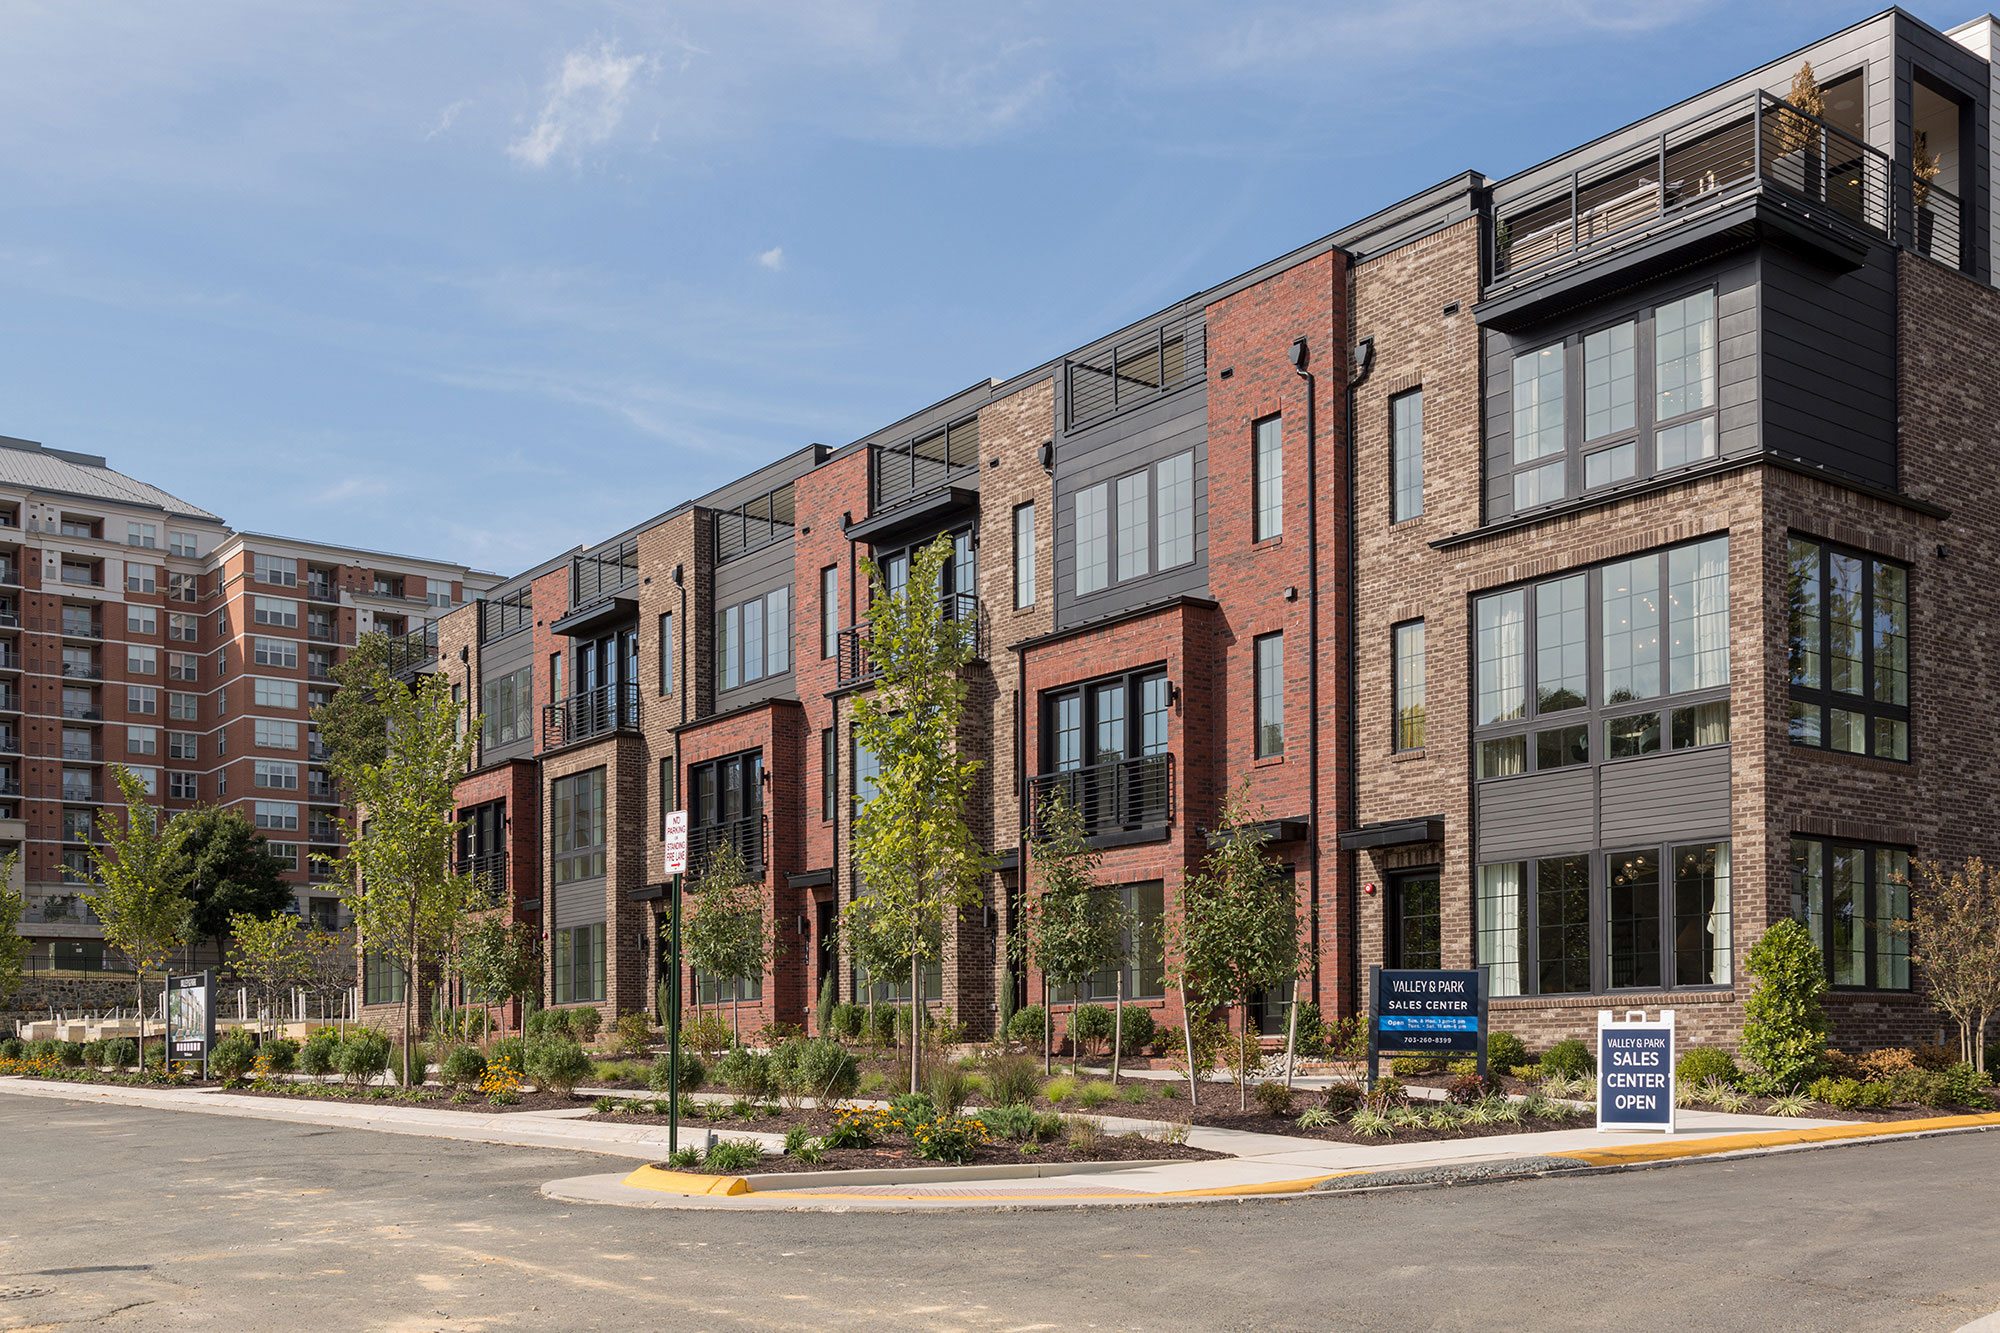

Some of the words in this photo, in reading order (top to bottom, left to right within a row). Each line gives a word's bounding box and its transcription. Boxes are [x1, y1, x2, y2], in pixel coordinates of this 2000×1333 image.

[672, 816, 681, 825] NO
[667, 825, 686, 835] PARKING
[666, 841, 686, 851] STANDING
[675, 850, 685, 861] LANE
[1392, 980, 1427, 993] VALLEY
[1428, 980, 1436, 993] &
[1438, 980, 1465, 993] PARK
[1388, 1000, 1422, 1010] SALES
[1425, 1000, 1468, 1010] CENTER
[1607, 1038, 1635, 1048] VALLEY
[1636, 1038, 1643, 1048] &
[1643, 1038, 1666, 1048] PARK
[1613, 1051, 1659, 1066] SALES
[1607, 1073, 1665, 1088] CENTER
[1615, 1094, 1656, 1110] OPEN
